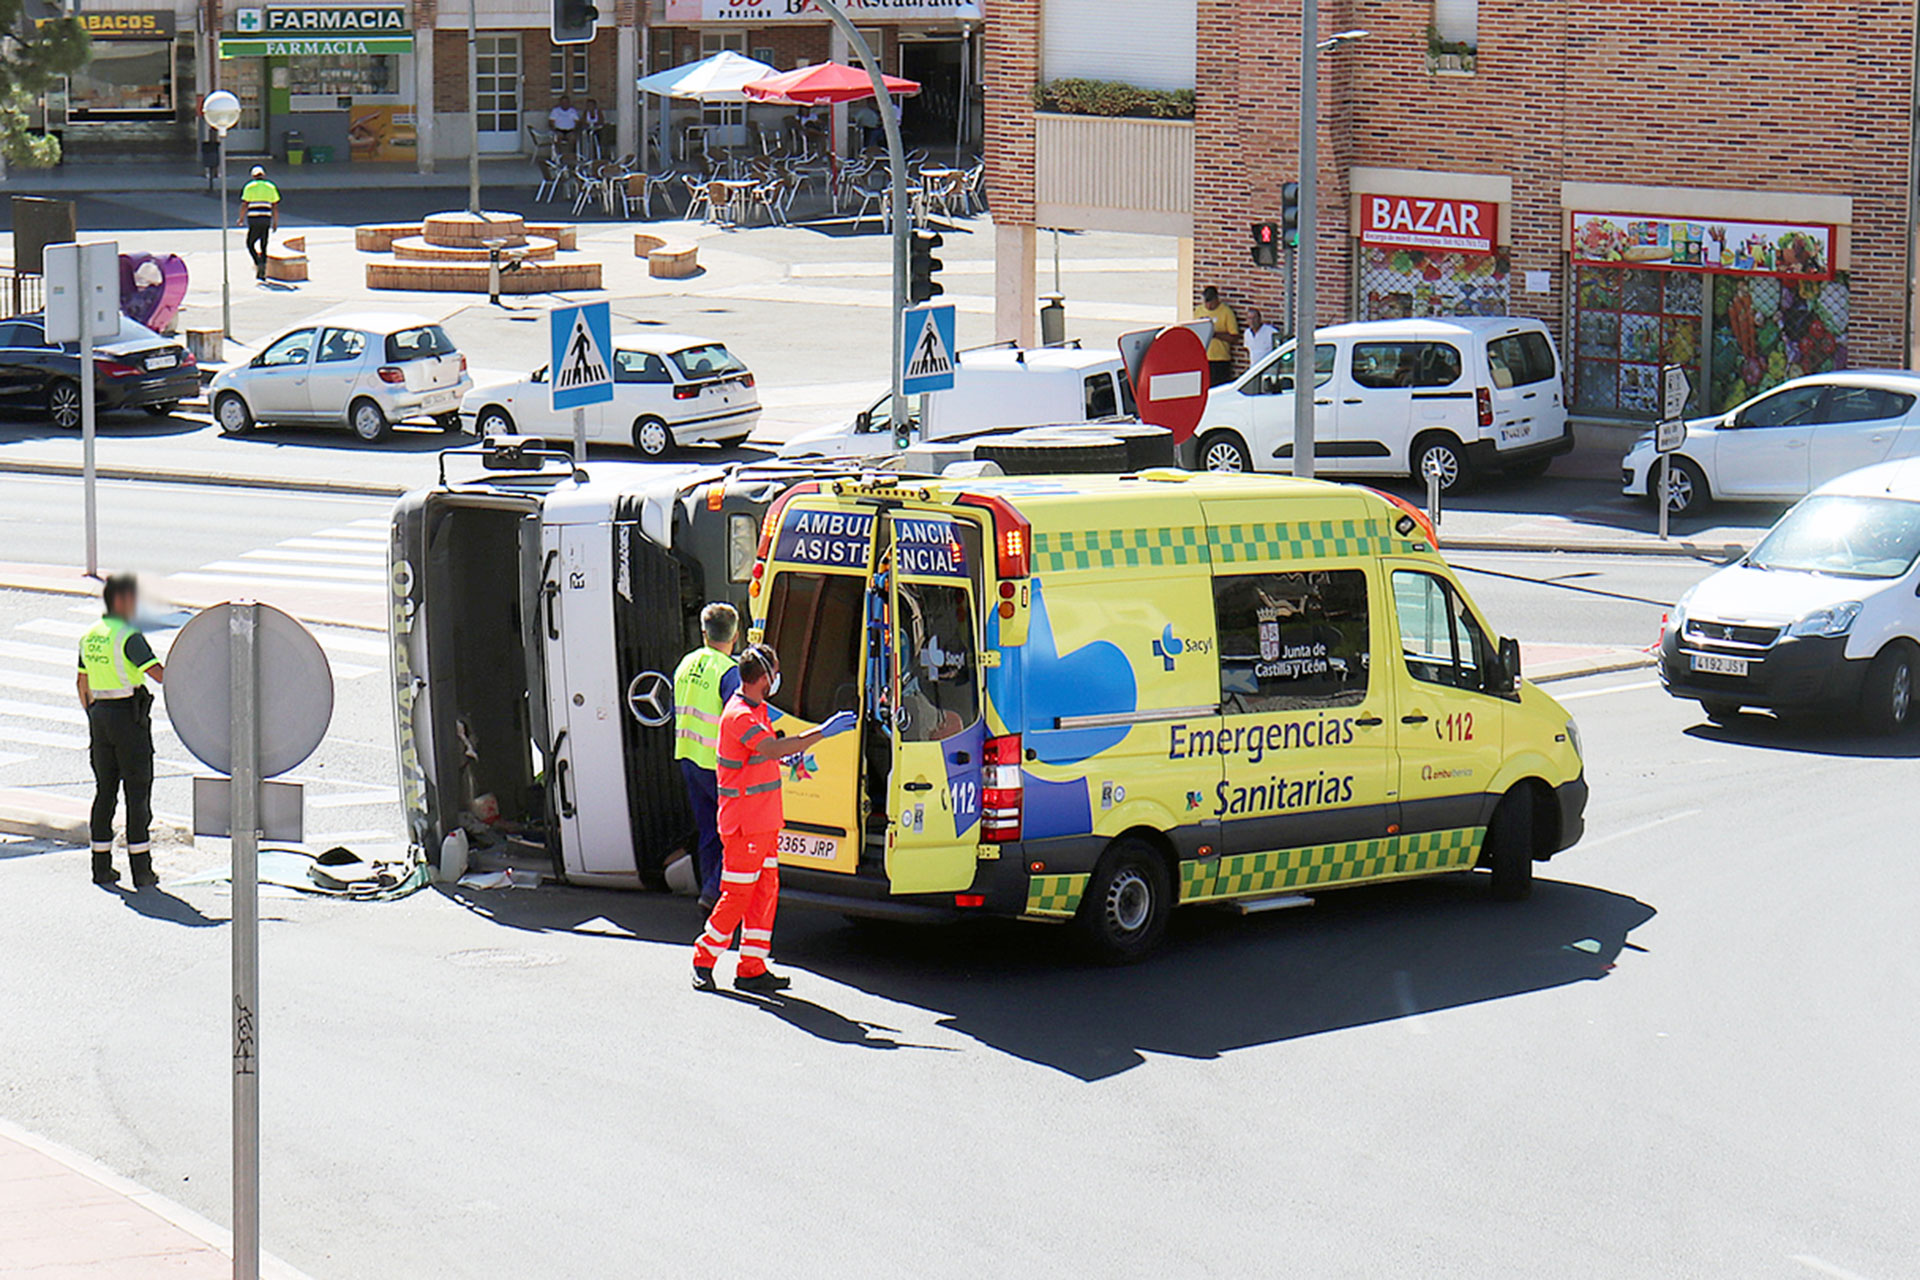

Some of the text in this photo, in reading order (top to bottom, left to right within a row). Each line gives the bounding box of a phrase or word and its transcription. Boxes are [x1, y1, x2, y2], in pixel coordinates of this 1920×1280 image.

[77, 15, 156, 29] ABACOS
[269, 11, 402, 29] FARMACIA
[266, 41, 368, 55] FARMACIA
[1372, 197, 1481, 236] BAZAR
[1185, 637, 1213, 654] Sacyl
[1282, 642, 1326, 659] Junta de
[1255, 659, 1328, 679] Castilla y León
[1446, 711, 1473, 742] 112
[1169, 712, 1354, 764] Emergencias
[951, 781, 976, 814] 112
[1213, 770, 1354, 816] Sanitarias
[777, 835, 835, 858] 2365 JRP
